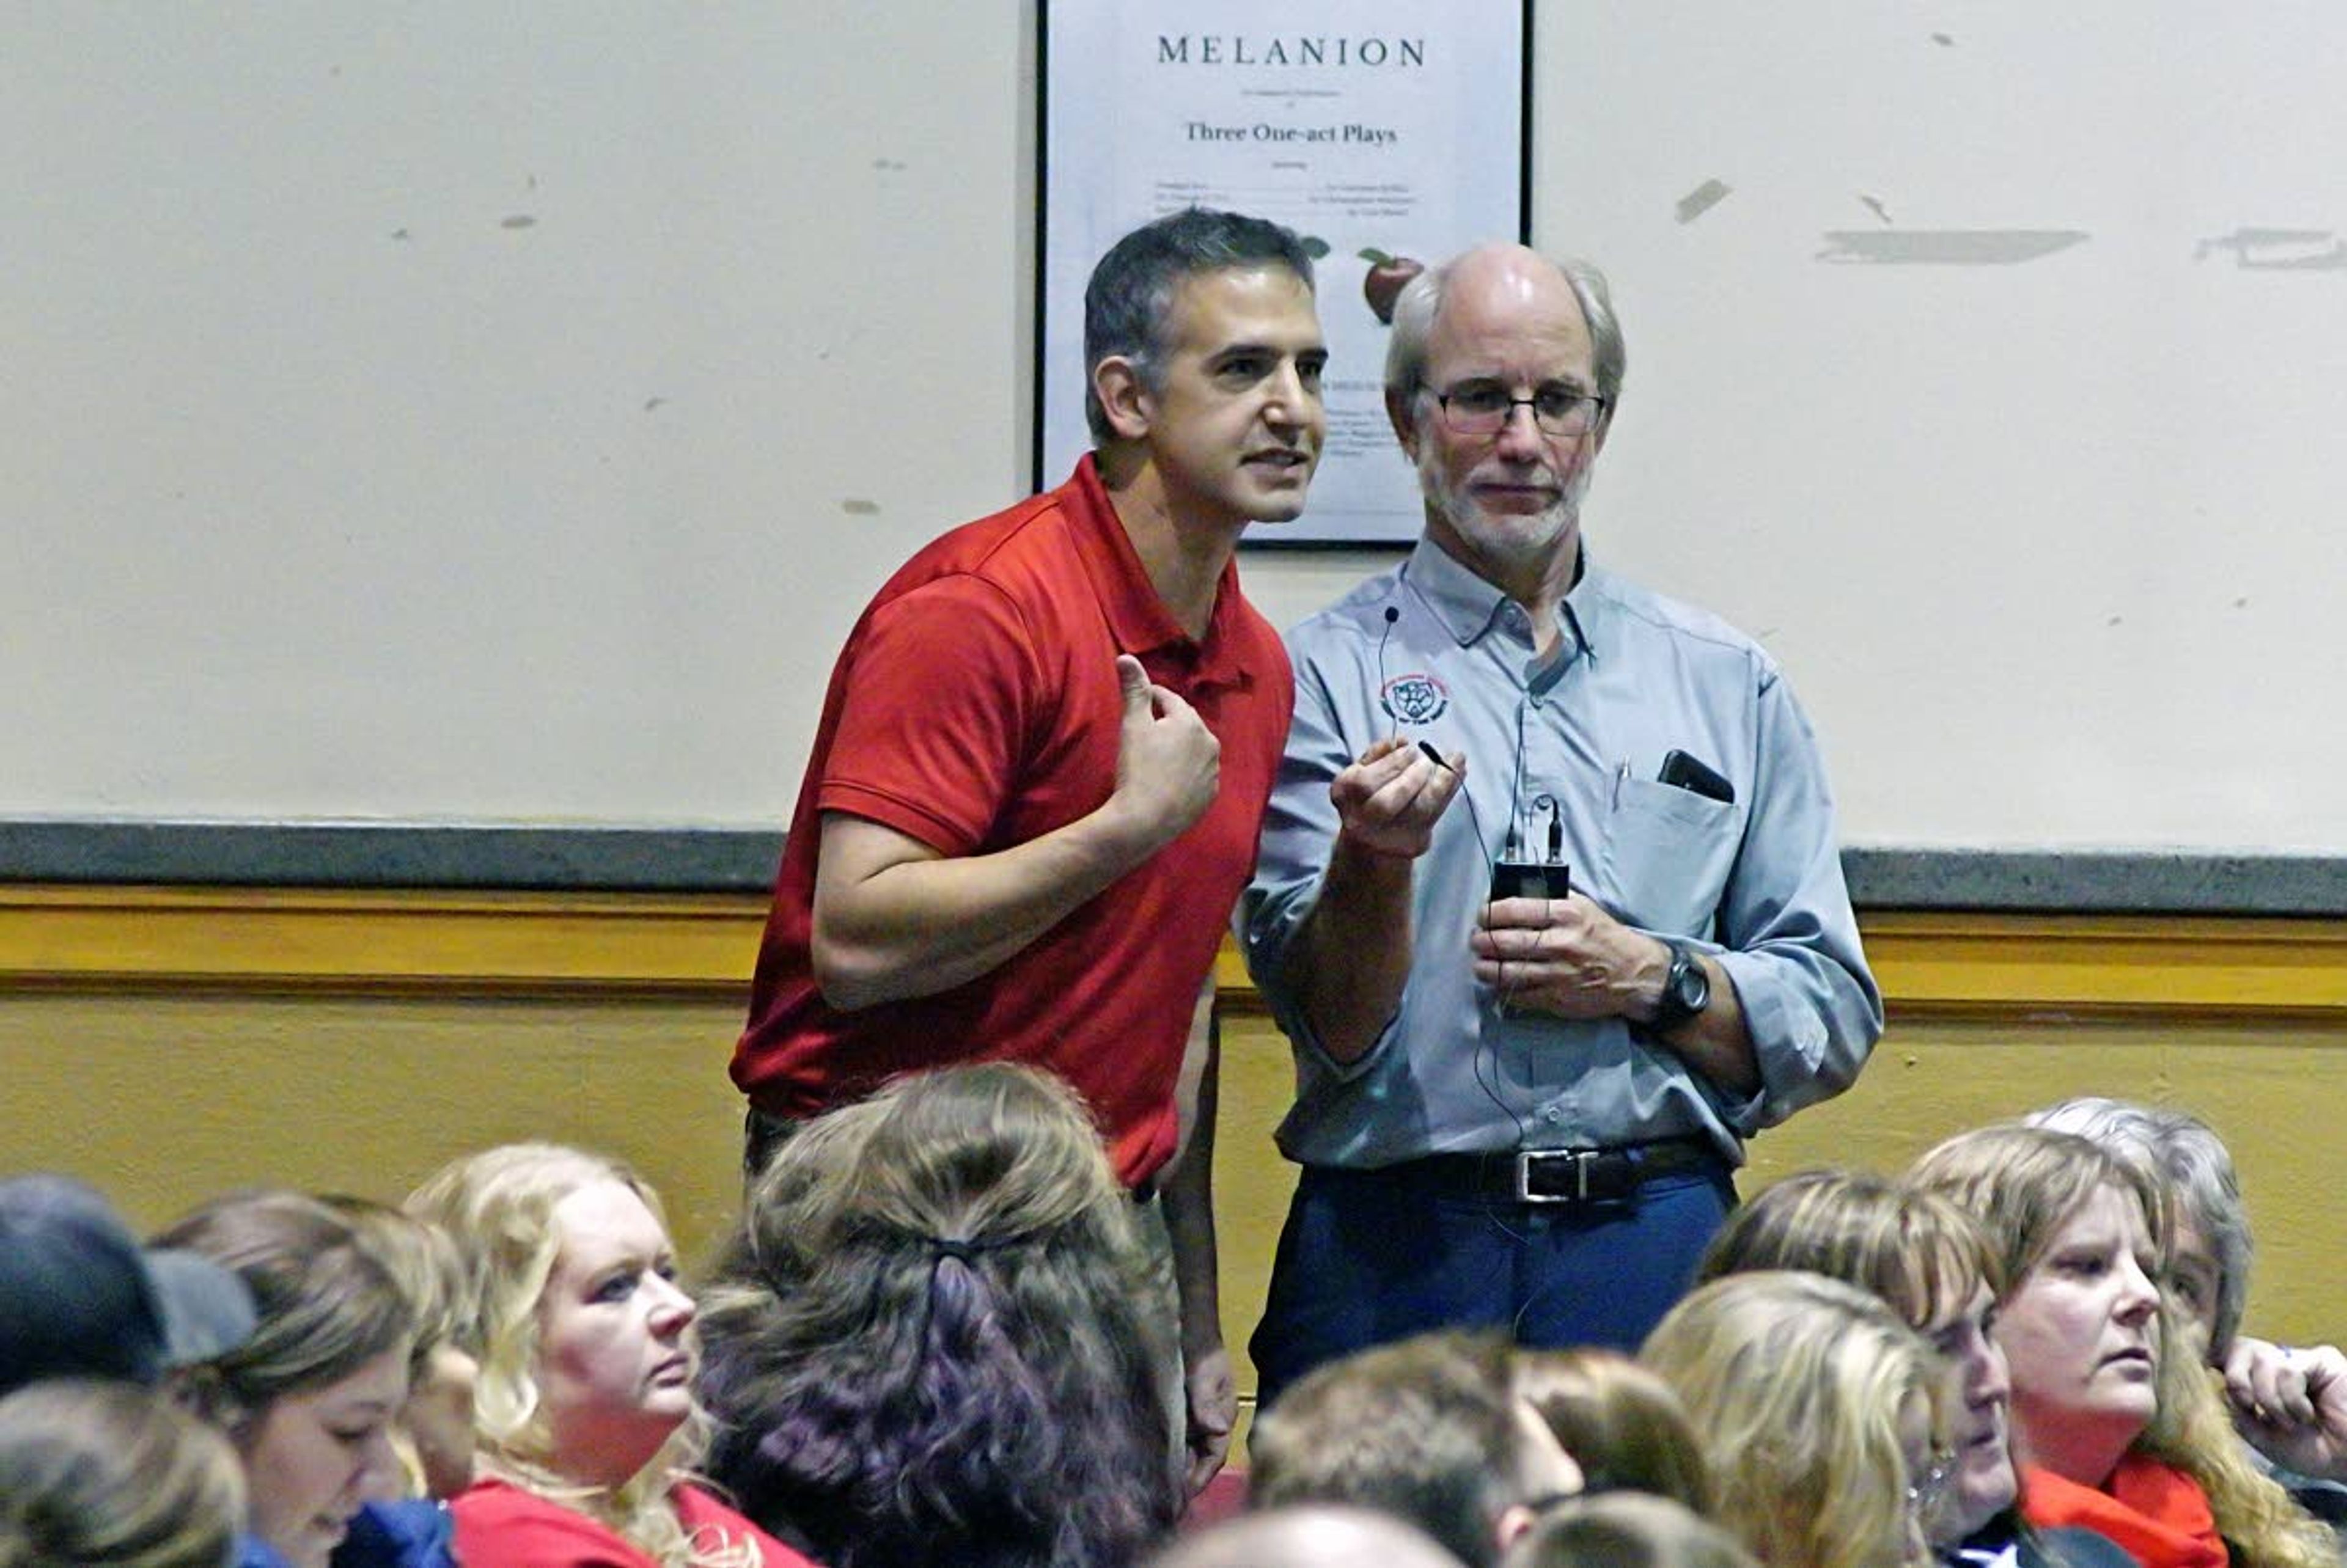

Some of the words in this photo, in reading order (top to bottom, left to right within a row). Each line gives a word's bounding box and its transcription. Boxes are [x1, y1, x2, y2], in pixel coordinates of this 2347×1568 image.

[1159, 35, 1425, 66] MELANION
[1186, 122, 1246, 141] Three
[1253, 123, 1335, 142] One-act
[1343, 124, 1397, 147] Plays
